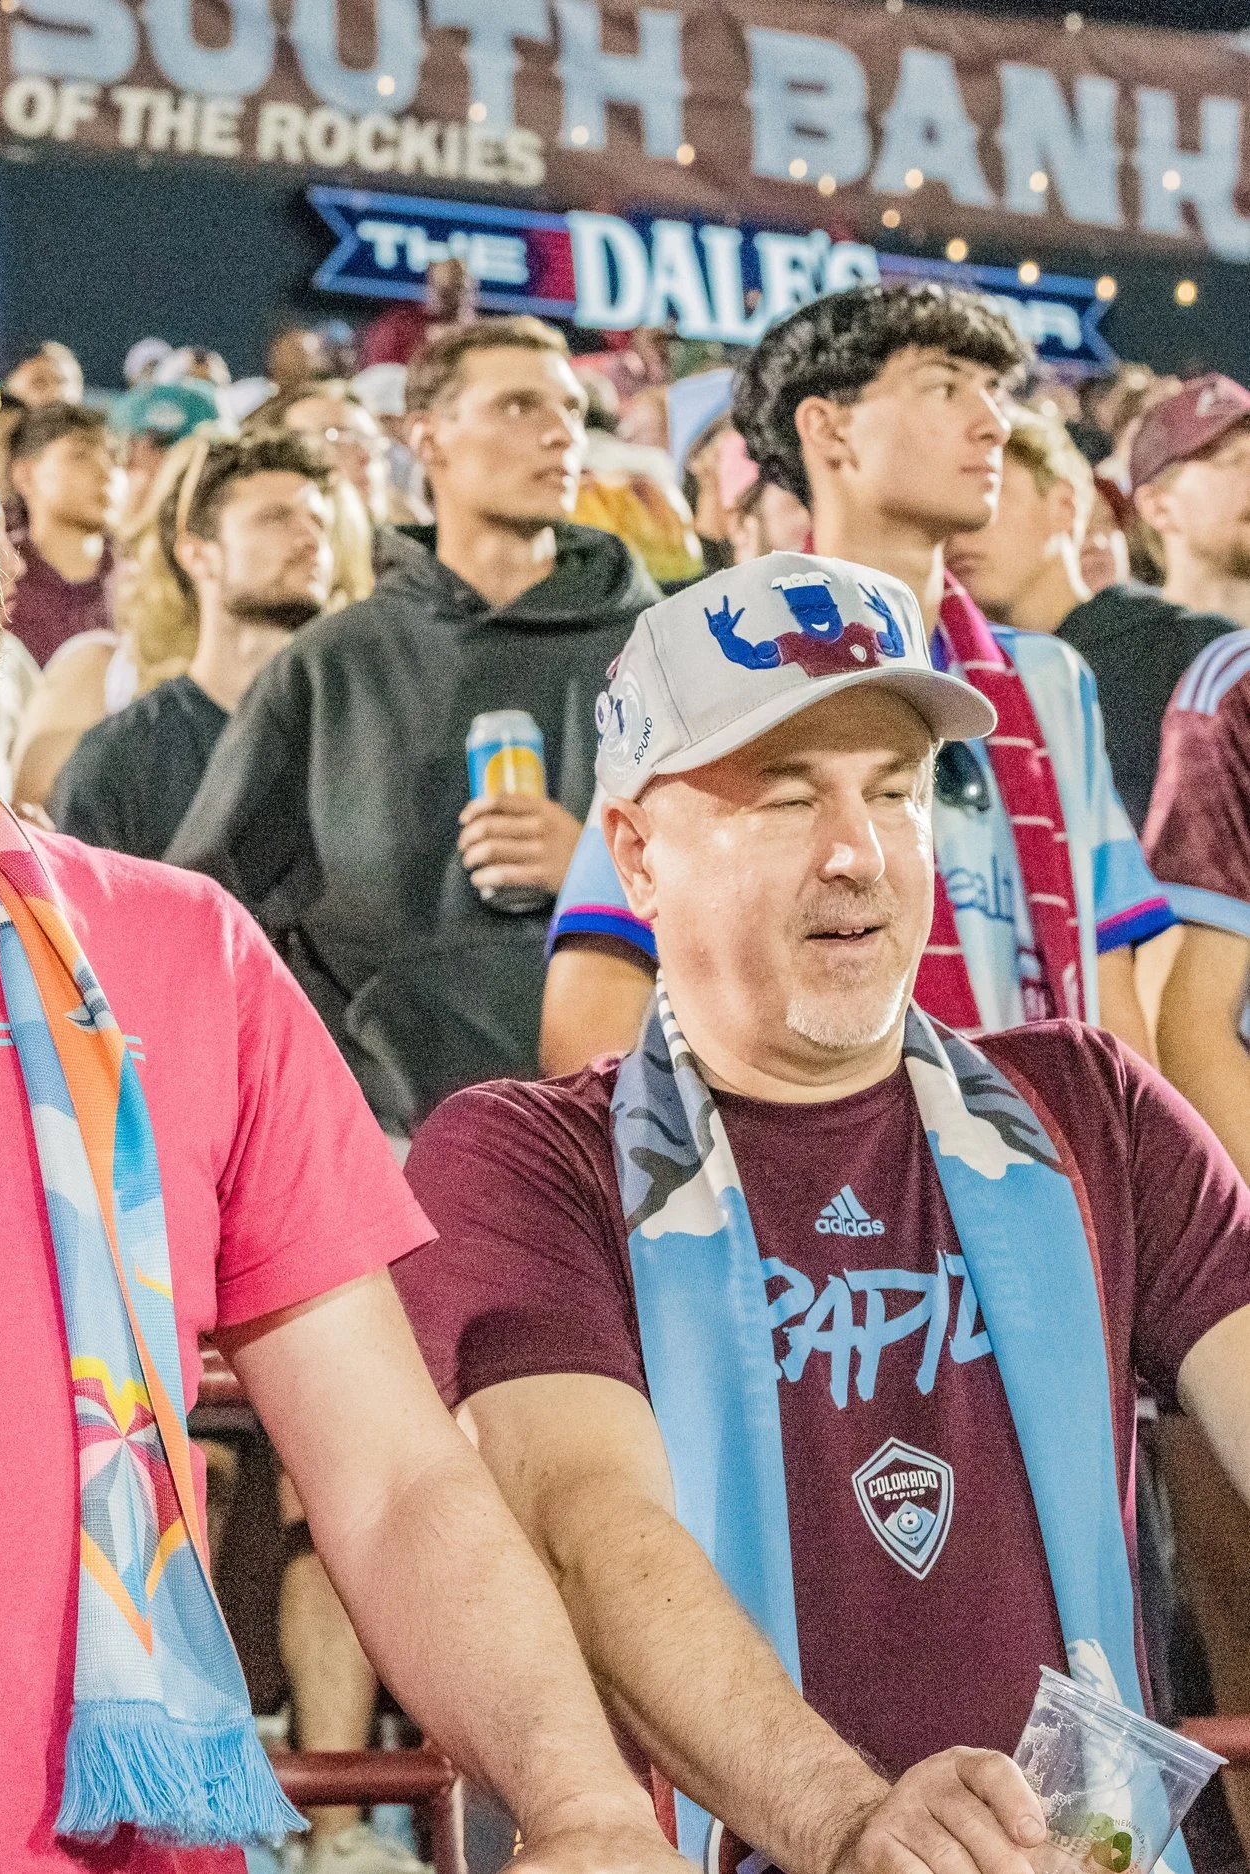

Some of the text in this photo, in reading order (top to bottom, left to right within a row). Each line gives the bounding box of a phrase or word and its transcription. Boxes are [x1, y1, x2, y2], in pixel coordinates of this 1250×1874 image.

[1, 77, 547, 188] OF THE ROCKIES
[12, 0, 1250, 263] SOUTH BANK
[356, 219, 530, 285] THE
[634, 716, 654, 765] SOUND
[815, 1216, 886, 1237] adidas
[868, 1470, 938, 1498] COLORADO
[883, 1488, 926, 1501] RAPIDS
